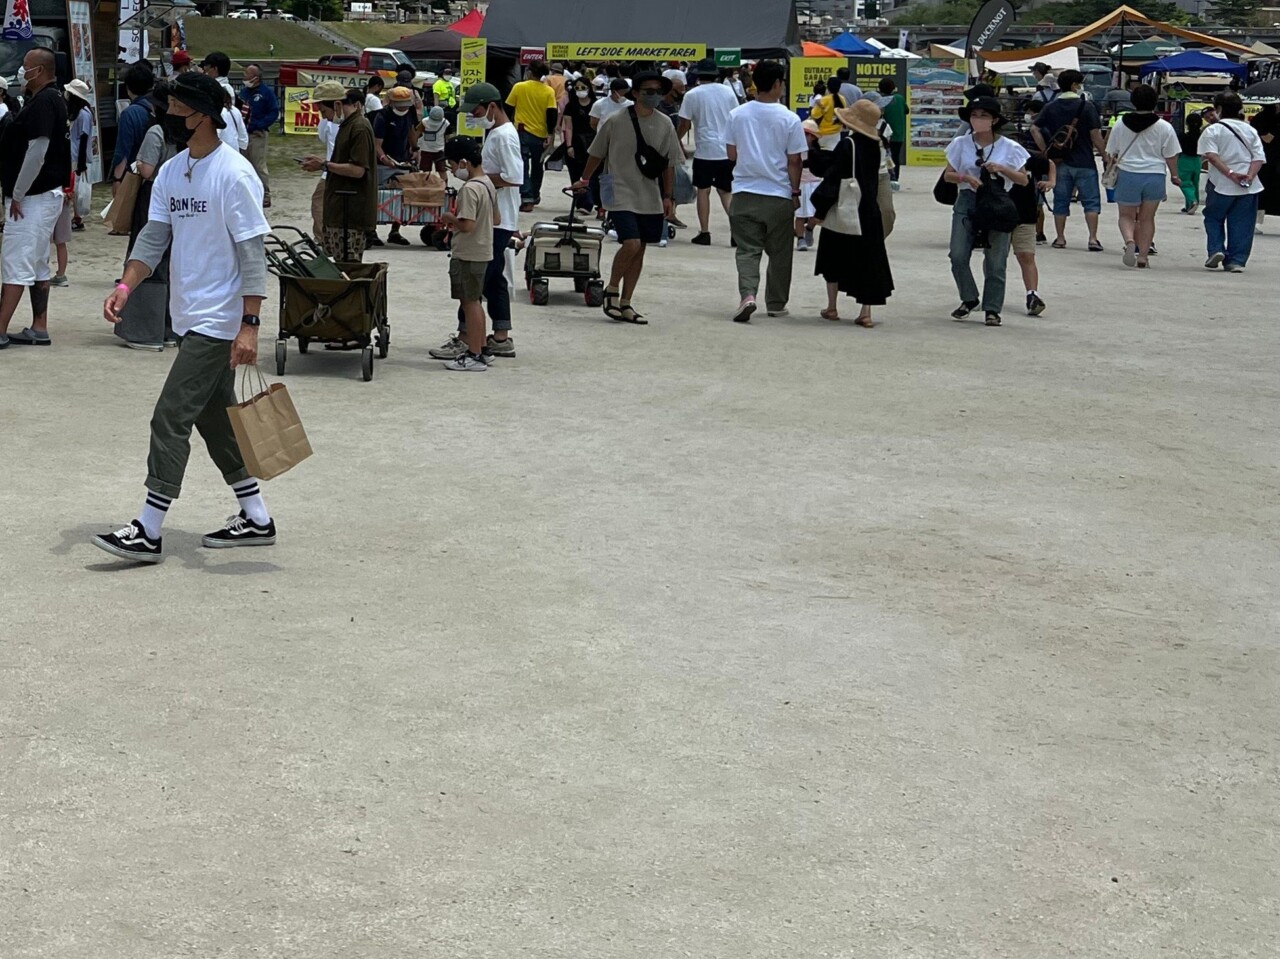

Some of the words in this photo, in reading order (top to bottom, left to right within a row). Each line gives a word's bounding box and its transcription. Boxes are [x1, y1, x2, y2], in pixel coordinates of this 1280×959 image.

[576, 47, 599, 56] LEFT
[600, 47, 623, 56] SIDE
[625, 47, 669, 57] MARKET
[670, 48, 696, 57] AREA
[463, 69, 482, 77] リスト
[856, 63, 897, 76] NOTICE
[311, 74, 368, 87] VINTAG
[190, 197, 208, 213] FREE
